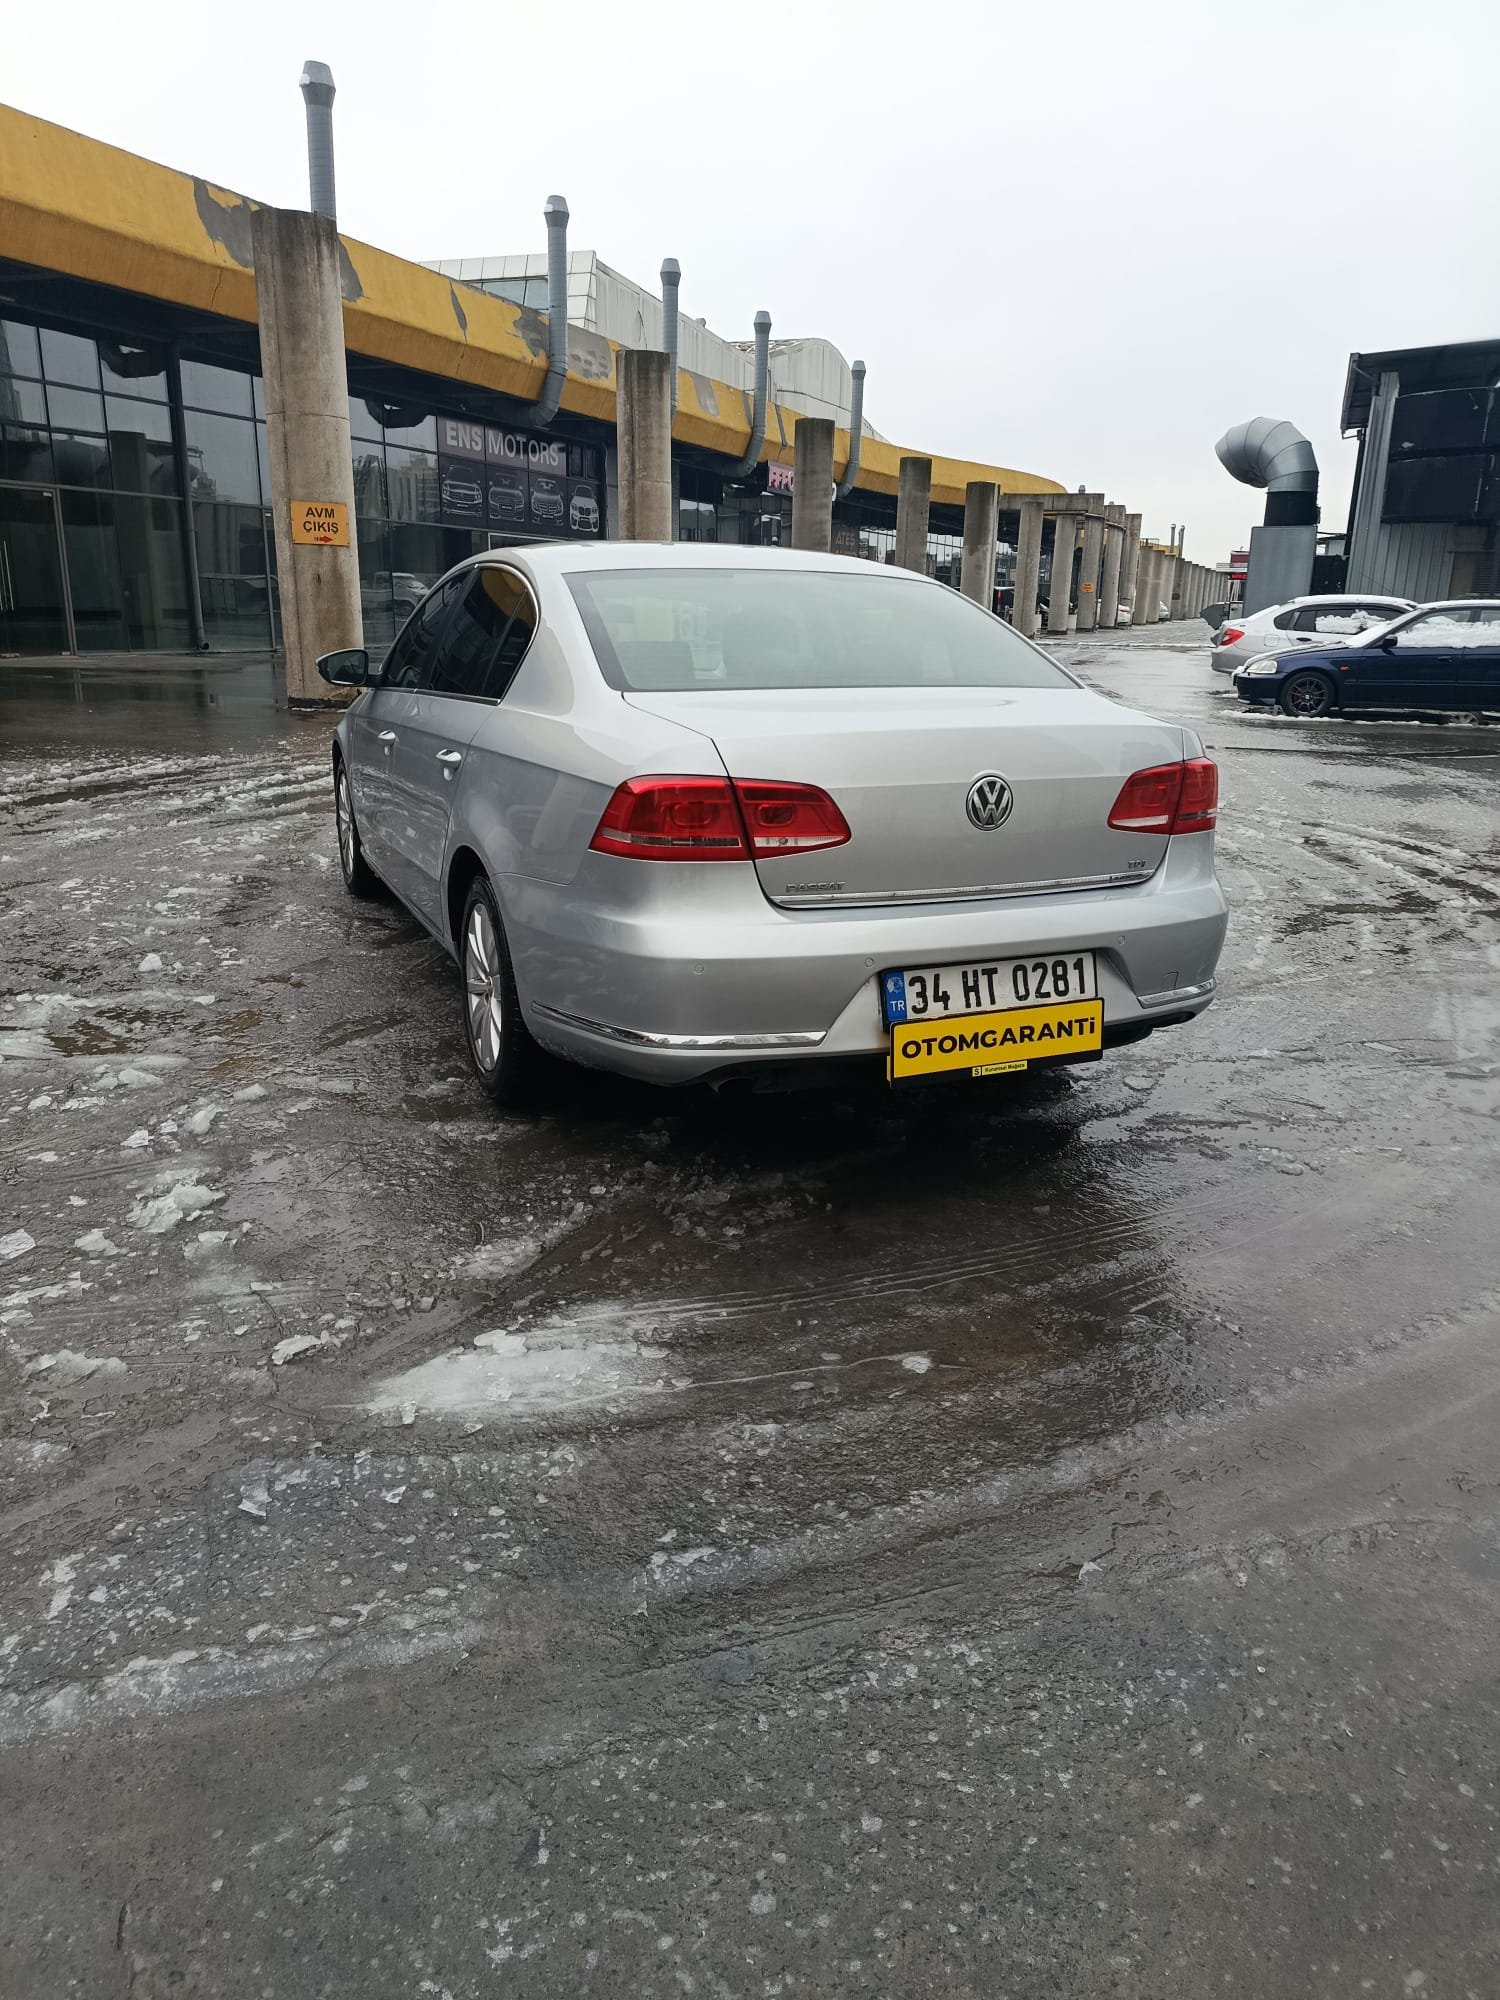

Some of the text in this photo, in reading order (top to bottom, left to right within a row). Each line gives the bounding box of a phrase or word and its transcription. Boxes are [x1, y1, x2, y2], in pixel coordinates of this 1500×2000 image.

[446, 421, 559, 466] ENS MOTORS
[305, 506, 335, 519] AVM
[303, 520, 339, 535] ÇIKIŞ
[785, 881, 846, 892] PASSAT
[908, 957, 1086, 1014] 34 HT 0281
[890, 1000, 905, 1012] TR
